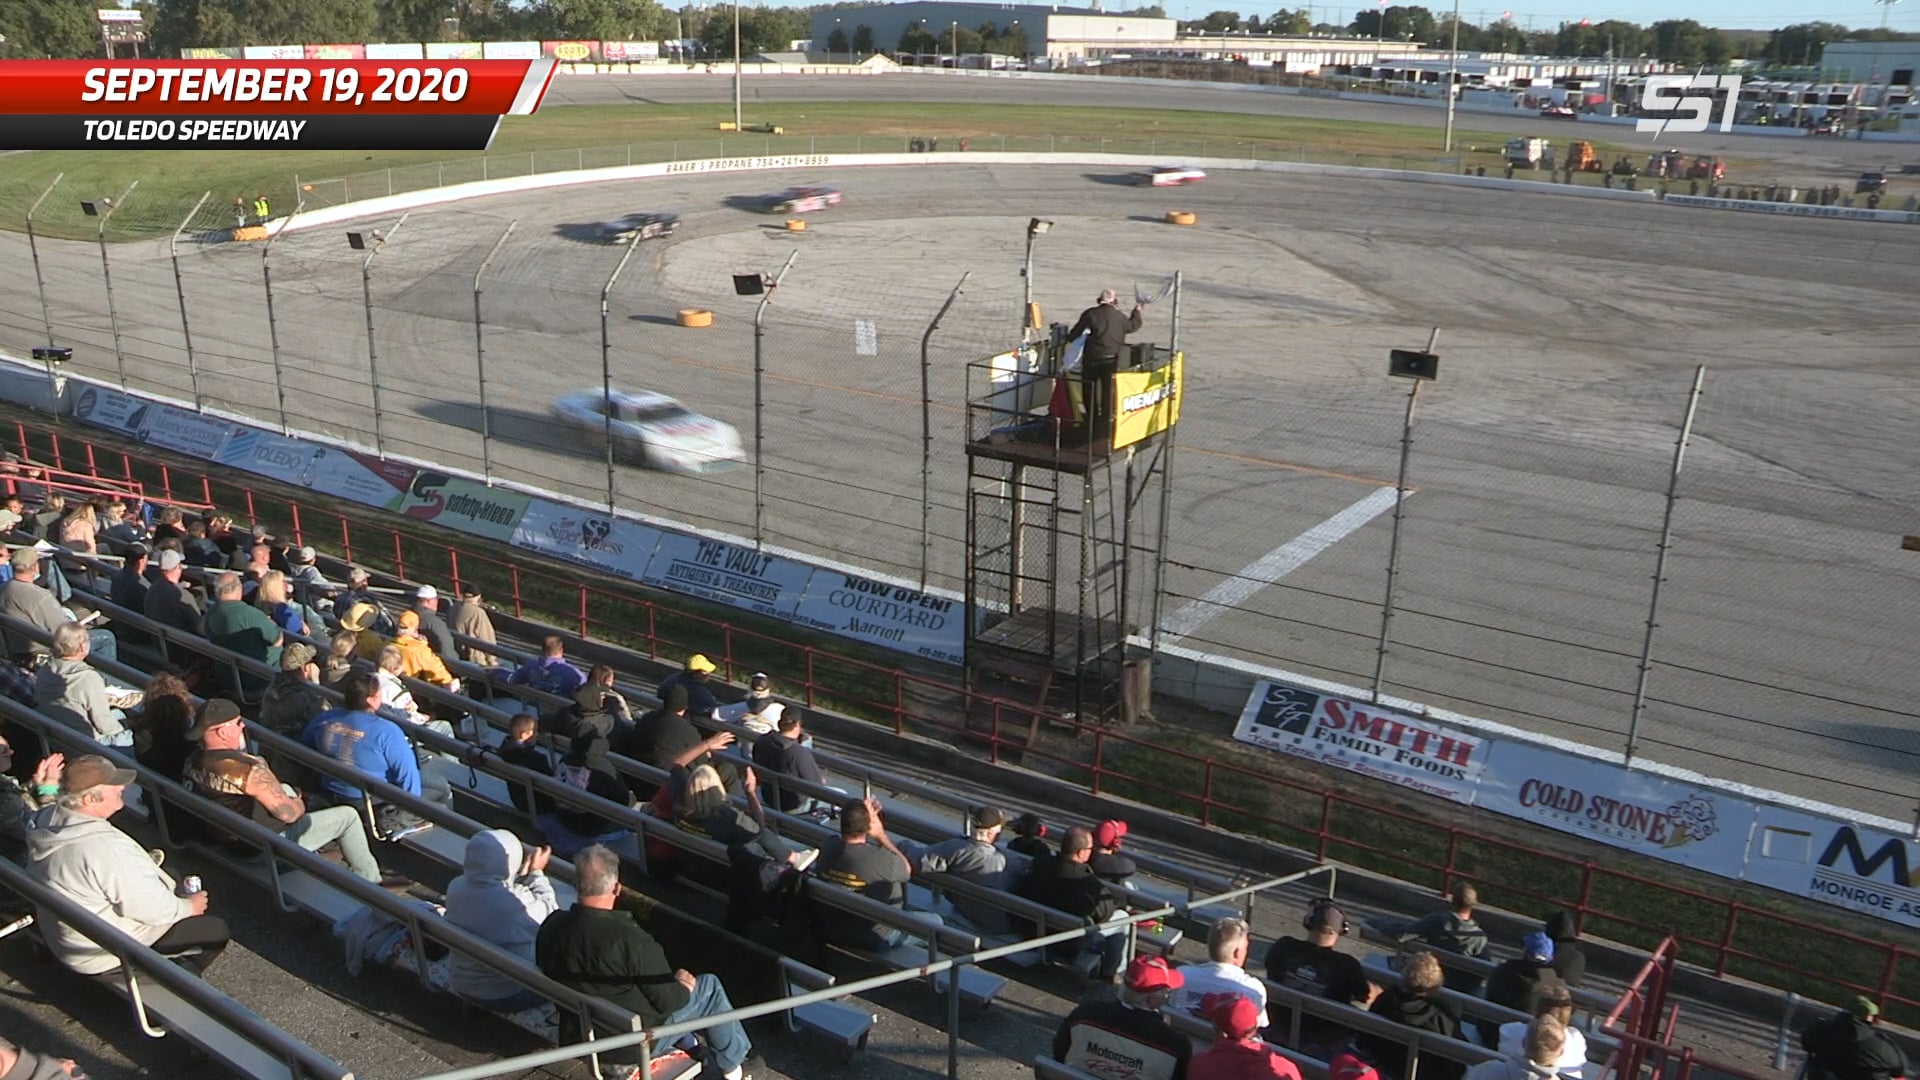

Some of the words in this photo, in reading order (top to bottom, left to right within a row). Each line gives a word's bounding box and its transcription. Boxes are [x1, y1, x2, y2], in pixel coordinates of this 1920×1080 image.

[666, 162, 705, 174] BAKER'S
[709, 158, 753, 170] PROPANE
[252, 444, 301, 470] TOLEDO
[445, 493, 516, 527] safety-kleen
[545, 522, 581, 545] Super
[694, 541, 723, 566] THE
[725, 548, 773, 577] VAULT
[666, 563, 714, 584] ANTIQUES
[712, 574, 721, 586] &
[722, 576, 781, 602] TREASURES
[844, 577, 890, 596] NOW
[894, 589, 953, 613] OPEN!
[829, 589, 945, 631] COURTYARD
[842, 617, 905, 642] Marriott
[1319, 698, 1476, 768] SMITH
[1312, 726, 1386, 757] FAMILY
[1393, 749, 1466, 781] FOODS
[1519, 778, 1584, 814] COLD
[1586, 795, 1670, 844] STONE
[1538, 808, 1638, 840] CREAMERY
[1817, 826, 1920, 888] M
[1810, 878, 1894, 910] MONROE
[1086, 1041, 1144, 1070] Motorcraft
